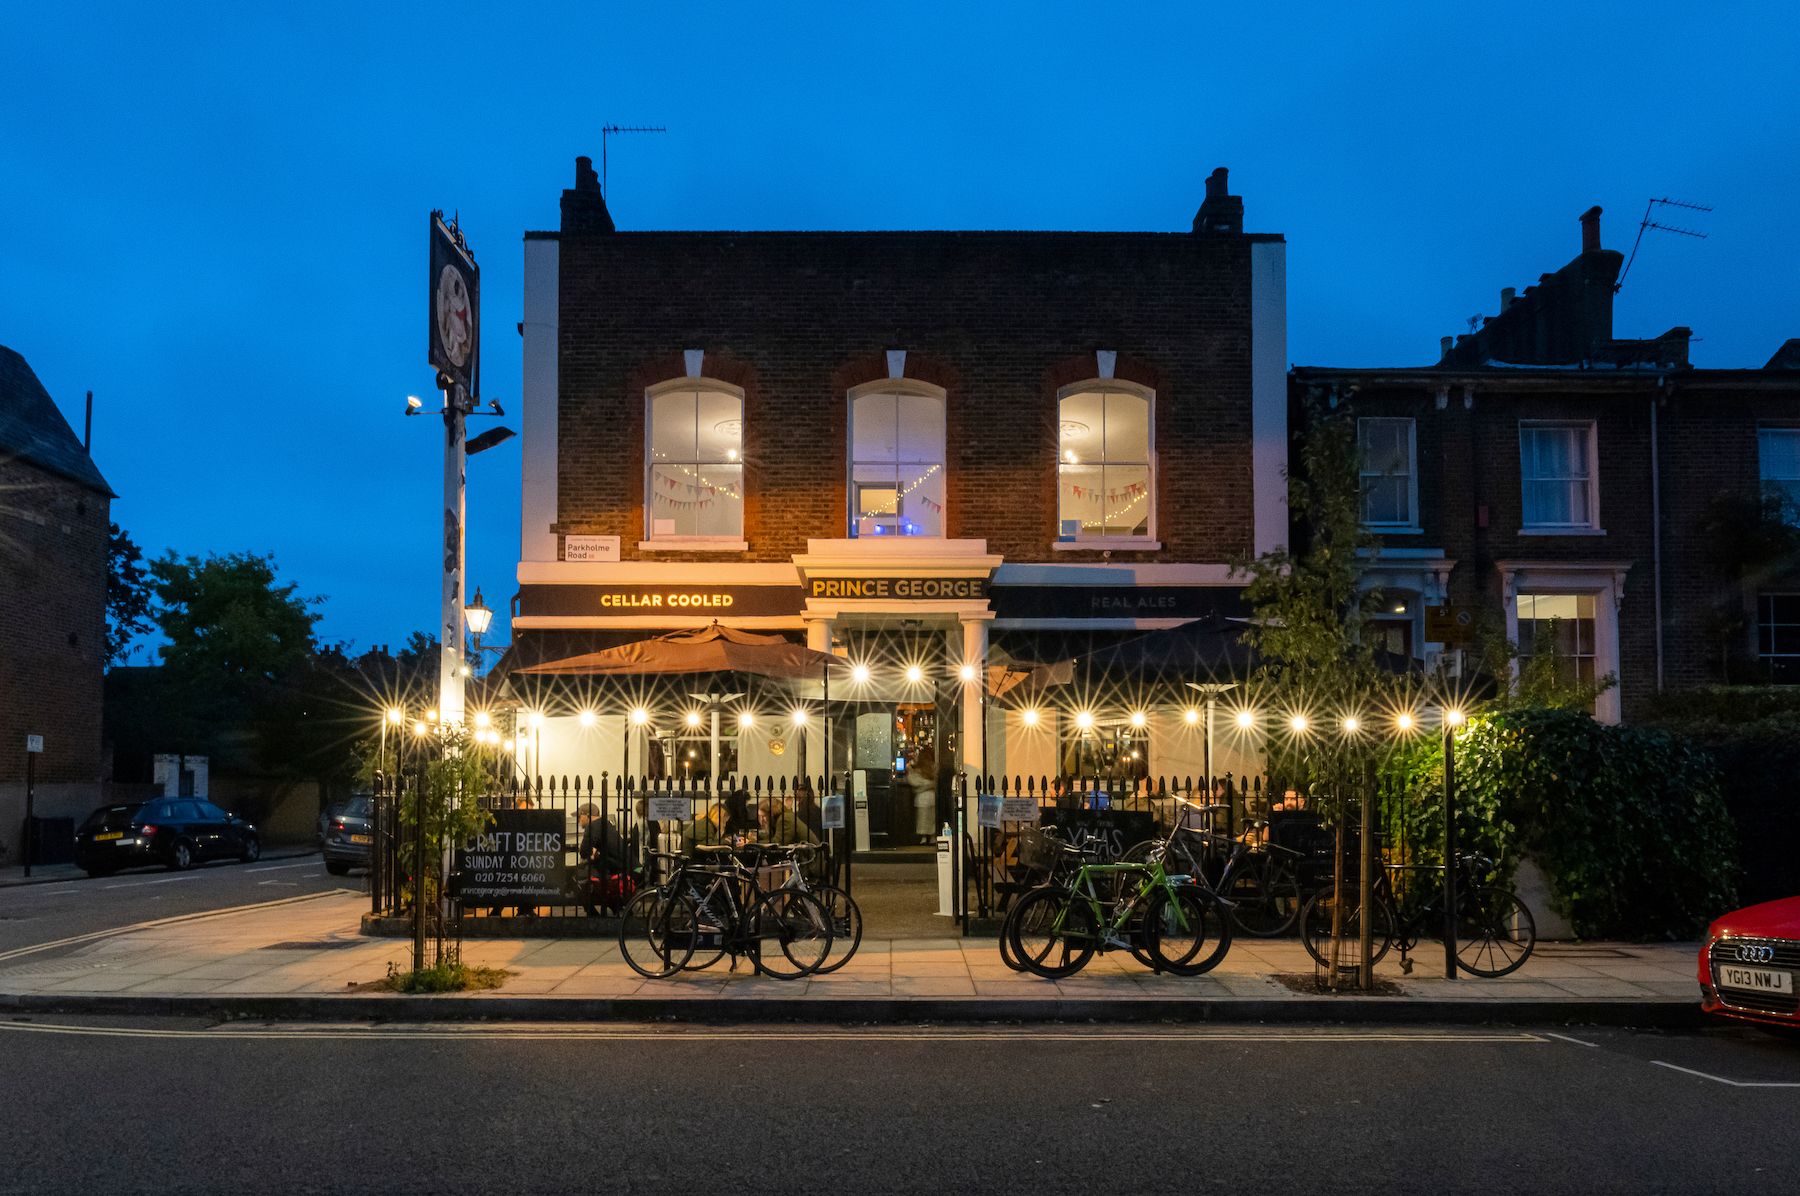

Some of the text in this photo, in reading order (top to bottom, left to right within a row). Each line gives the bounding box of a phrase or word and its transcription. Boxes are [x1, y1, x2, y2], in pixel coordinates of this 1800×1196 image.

[813, 580, 982, 597] PRINCE GEORGE
[601, 594, 733, 607] CELLAR COOLED
[1091, 596, 1177, 608] REAL ALES
[516, 832, 561, 852] BEERS
[465, 856, 555, 869] SUNDAY ROASTS
[475, 873, 494, 882] 020
[496, 872, 519, 882] 7254
[1726, 969, 1782, 988] YG13 NWJ
